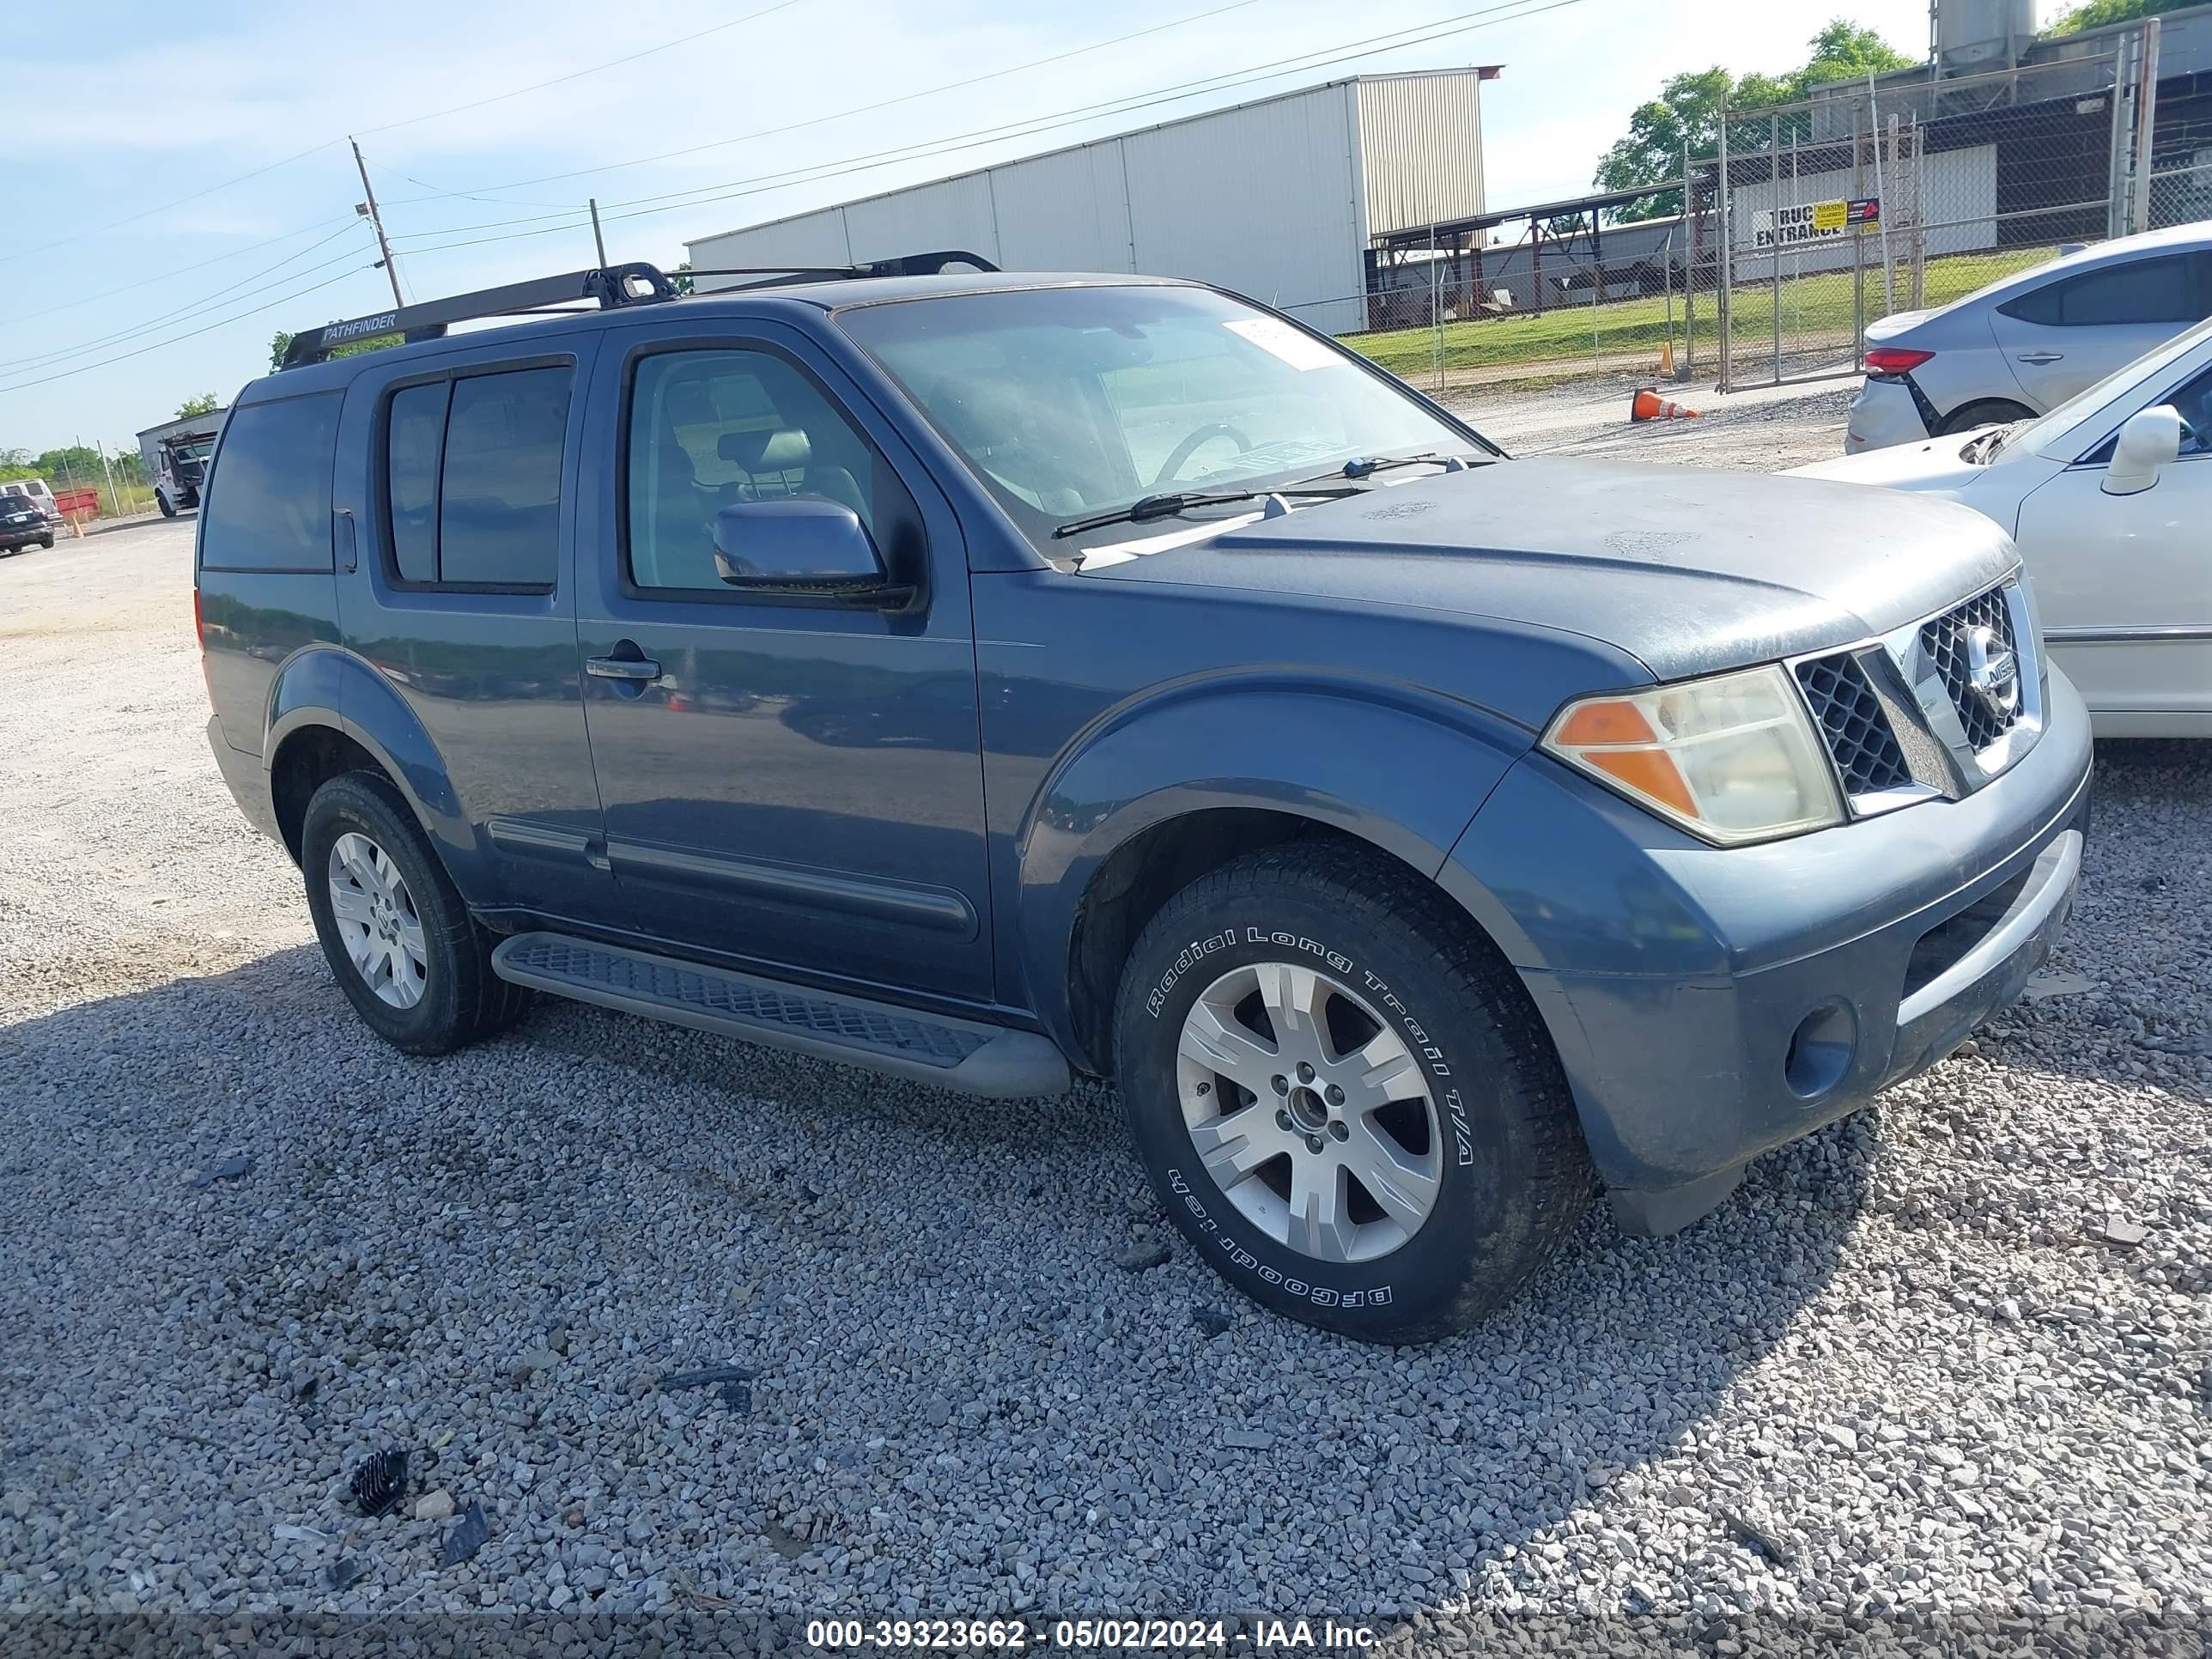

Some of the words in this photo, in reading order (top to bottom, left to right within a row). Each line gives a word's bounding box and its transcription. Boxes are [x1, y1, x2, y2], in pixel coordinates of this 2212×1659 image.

[1769, 204, 1814, 228] TRUC
[1817, 204, 1845, 213] WARNING
[323, 313, 397, 341] PATHFINDER
[1146, 928, 1237, 1019] Radial
[1246, 927, 1354, 975] Long
[1364, 969, 1452, 1077] Trail
[1444, 1088, 1474, 1166] T/A
[1167, 1169, 1395, 1309] BFGoodrich
